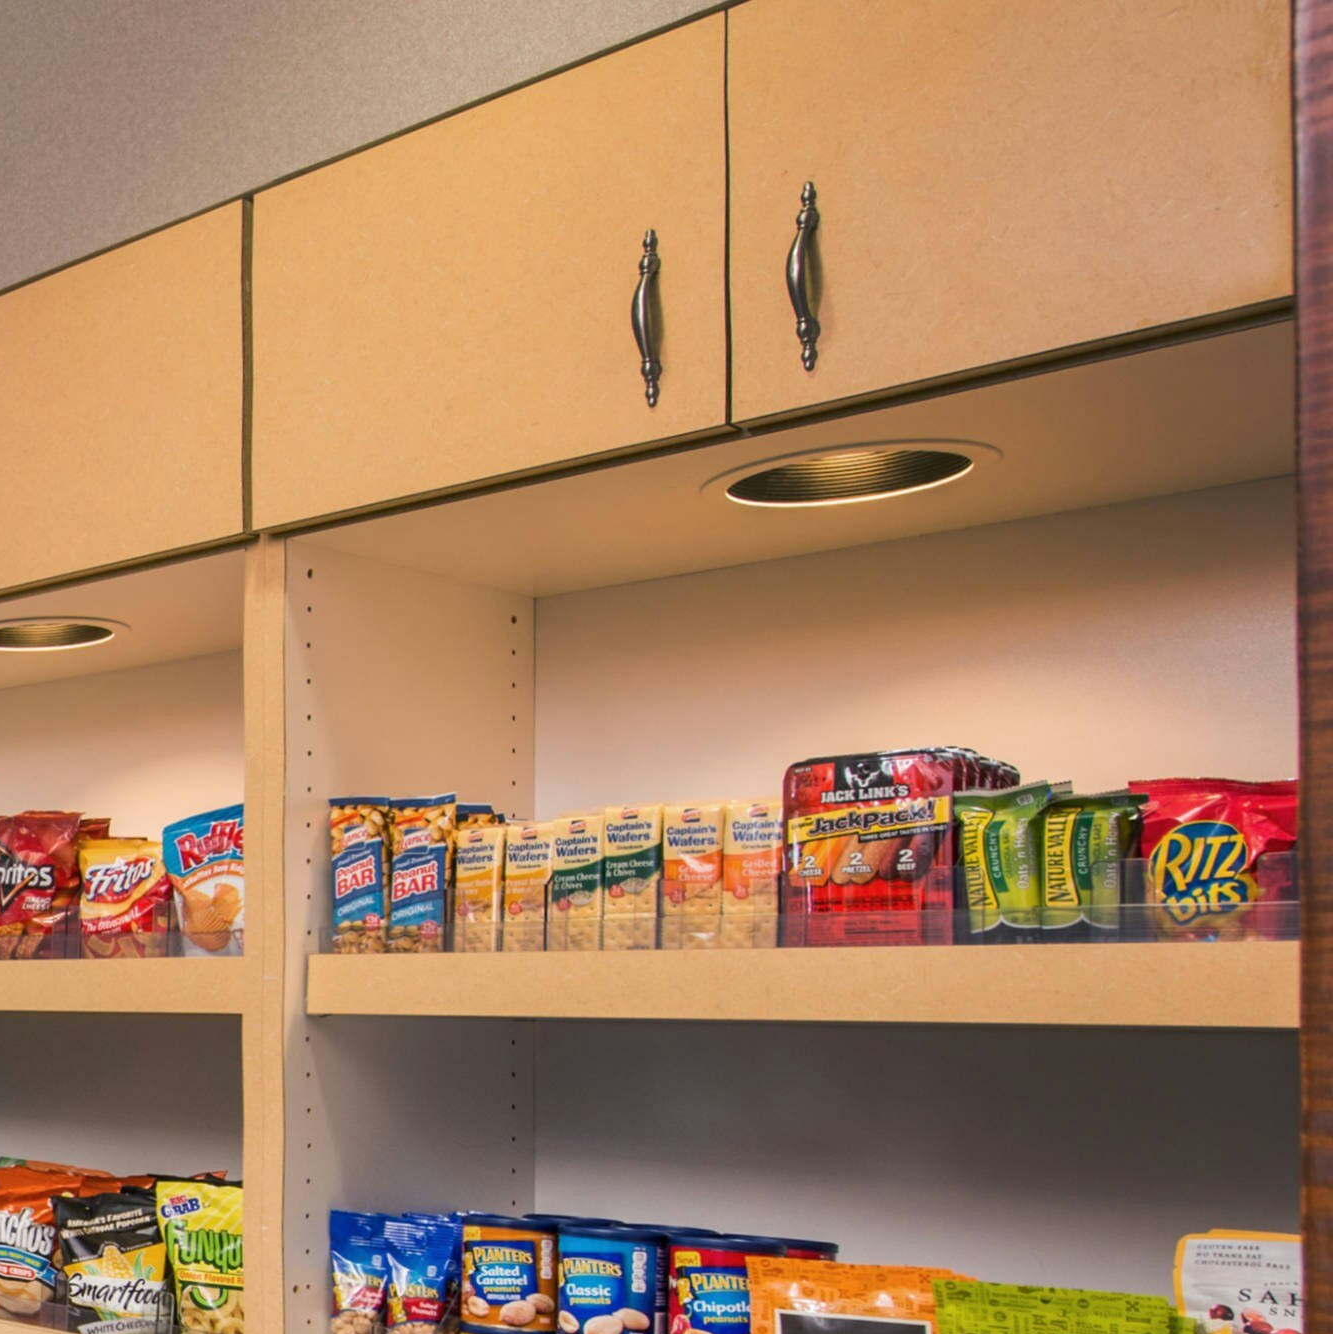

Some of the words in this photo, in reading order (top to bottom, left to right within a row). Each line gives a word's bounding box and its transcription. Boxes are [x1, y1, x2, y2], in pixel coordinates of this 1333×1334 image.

[821, 789, 856, 804] JACK
[859, 784, 909, 800] LINK'S
[607, 821, 652, 833] Captain's
[667, 825, 716, 836] Captain's
[732, 819, 783, 831] Captain's
[1048, 807, 1072, 852] VALLEY
[607, 831, 650, 844] Wafers
[733, 830, 782, 842] Wafers
[964, 811, 990, 857] VALLEY
[508, 842, 550, 852] Captain's
[555, 836, 598, 847] Captain's
[667, 835, 715, 848] Wafers
[456, 844, 494, 854] Captain's
[556, 846, 597, 858] Wafers
[899, 849, 913, 862] 2
[989, 832, 1002, 878] CRUNCHY
[1078, 827, 1089, 875] CRUNCHY
[457, 855, 493, 865] Wafers
[508, 852, 549, 863] Wafers
[805, 856, 816, 868] 2
[850, 853, 862, 865] 2
[336, 856, 375, 879] Peanut
[393, 860, 438, 883] Peanut
[897, 862, 917, 871] BEEF
[1154, 833, 1245, 897] RITZ
[85, 856, 156, 900] Fritos
[967, 858, 994, 907] NATURE
[1017, 865, 1031, 890] Oats
[1047, 852, 1074, 902] NATURE
[1104, 865, 1118, 889] Oats
[336, 869, 375, 899] BAR
[392, 874, 438, 902] BAR
[337, 896, 375, 917] ORIGINAL
[1166, 882, 1242, 922] bits
[391, 903, 435, 921] ORIGINAL
[161, 1196, 201, 1219] GRAB
[472, 1246, 533, 1265] PLANTERS
[676, 1256, 698, 1266] New!
[481, 1266, 520, 1277] Salted
[563, 1258, 622, 1277] PLANTERS
[476, 1275, 528, 1286] Caramel
[69, 1273, 168, 1310] Smartfood
[483, 1285, 521, 1293] peanuts
[566, 1284, 611, 1297] Classic
[569, 1296, 611, 1305] peanuts
[703, 1315, 748, 1324] peanuts
